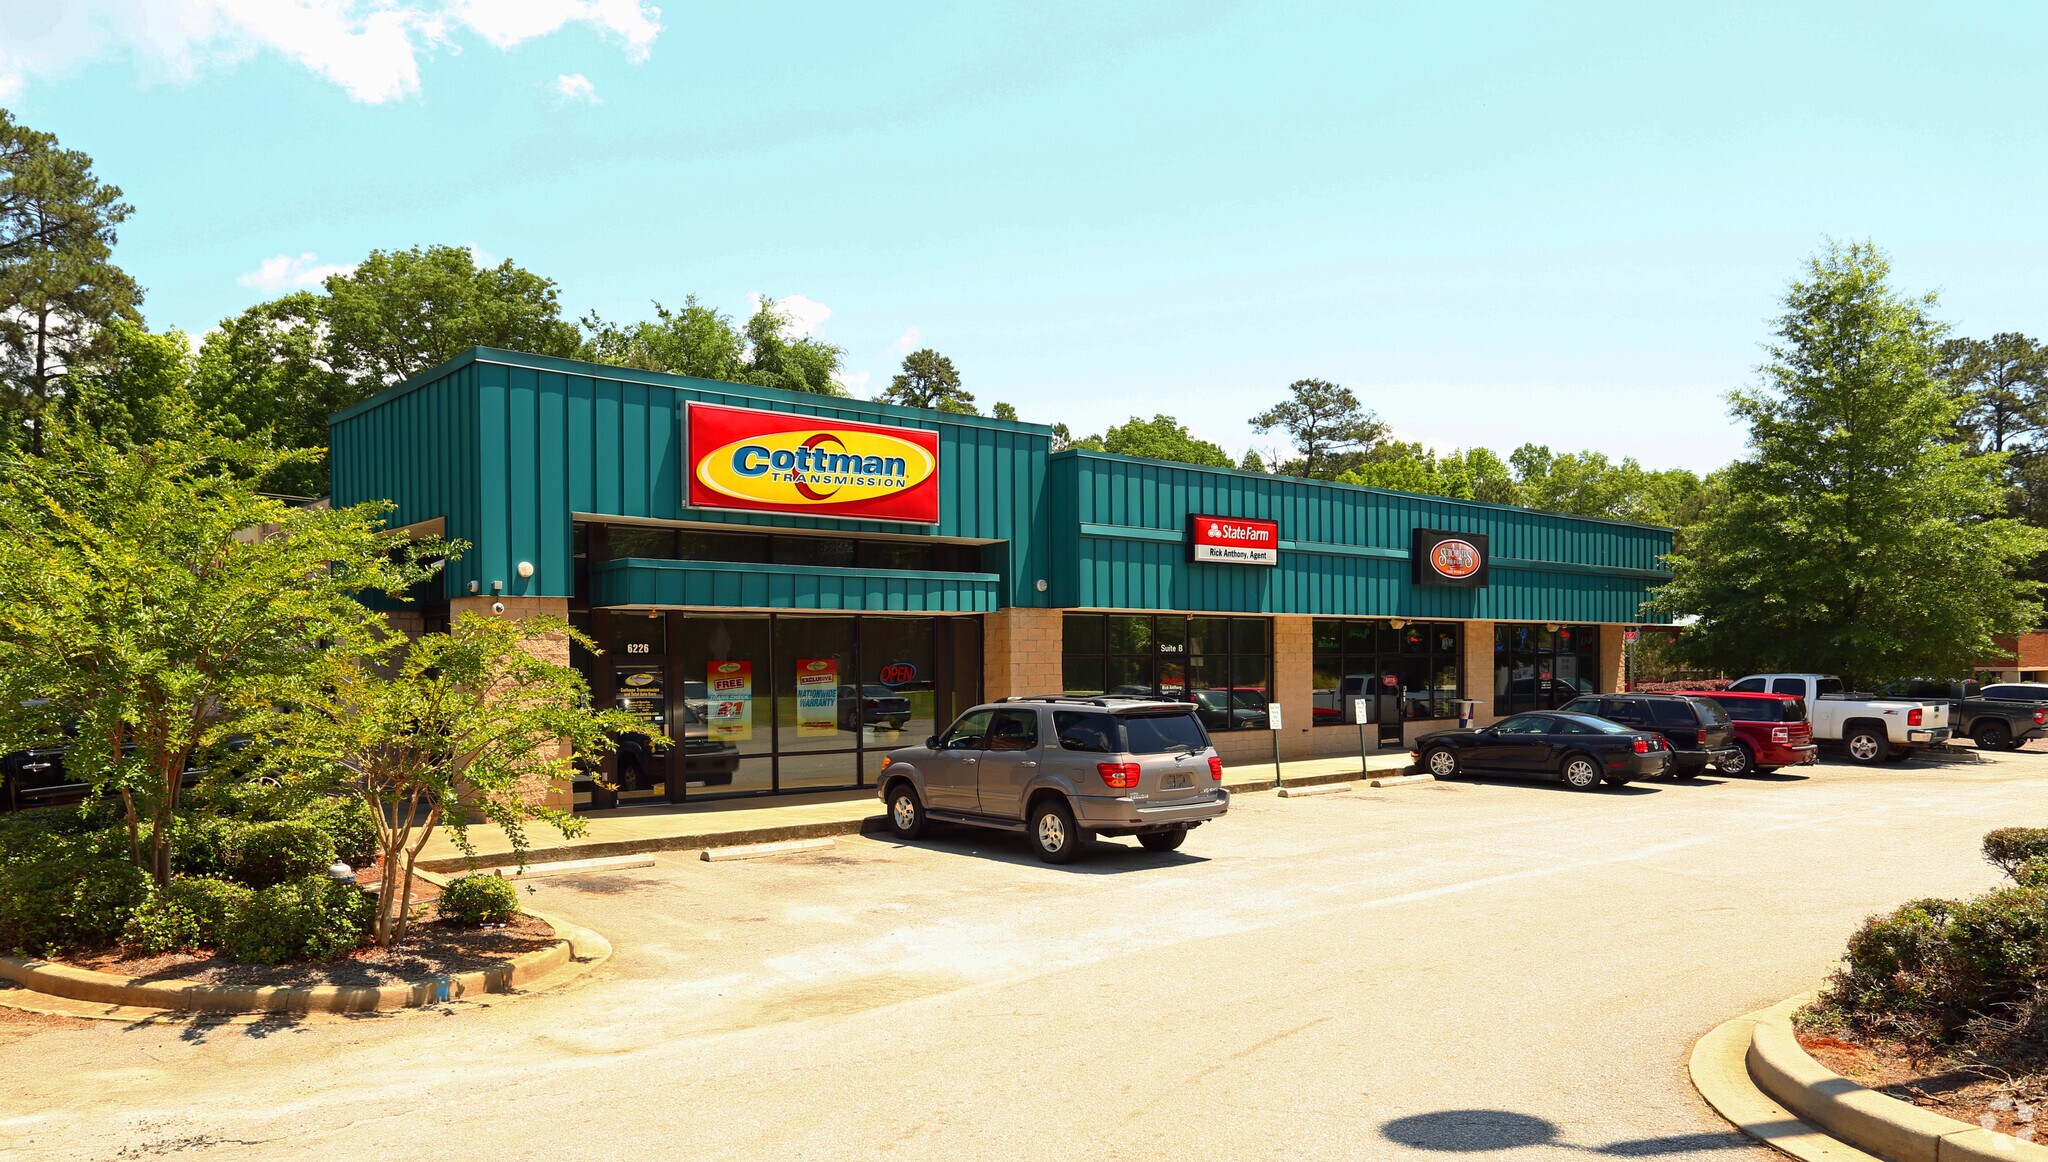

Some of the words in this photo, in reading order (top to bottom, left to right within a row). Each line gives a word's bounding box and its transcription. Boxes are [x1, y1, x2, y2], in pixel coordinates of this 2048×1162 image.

[731, 444, 907, 478] Cottman
[772, 473, 906, 488] TRANSMISSION
[1209, 548, 1222, 557] Rick
[1223, 549, 1249, 560] Anthony,
[1250, 551, 1267, 560] Agent
[627, 643, 649, 654] 6226
[1160, 644, 1177, 652] Suite
[1178, 644, 1184, 652] B
[801, 675, 832, 683] EXCLUSIVE
[880, 665, 913, 683] OPEN
[715, 678, 743, 689] FREE
[797, 689, 837, 698] NATIONWIDE
[718, 701, 744, 712] 21
[800, 698, 835, 707] WARRANTY
